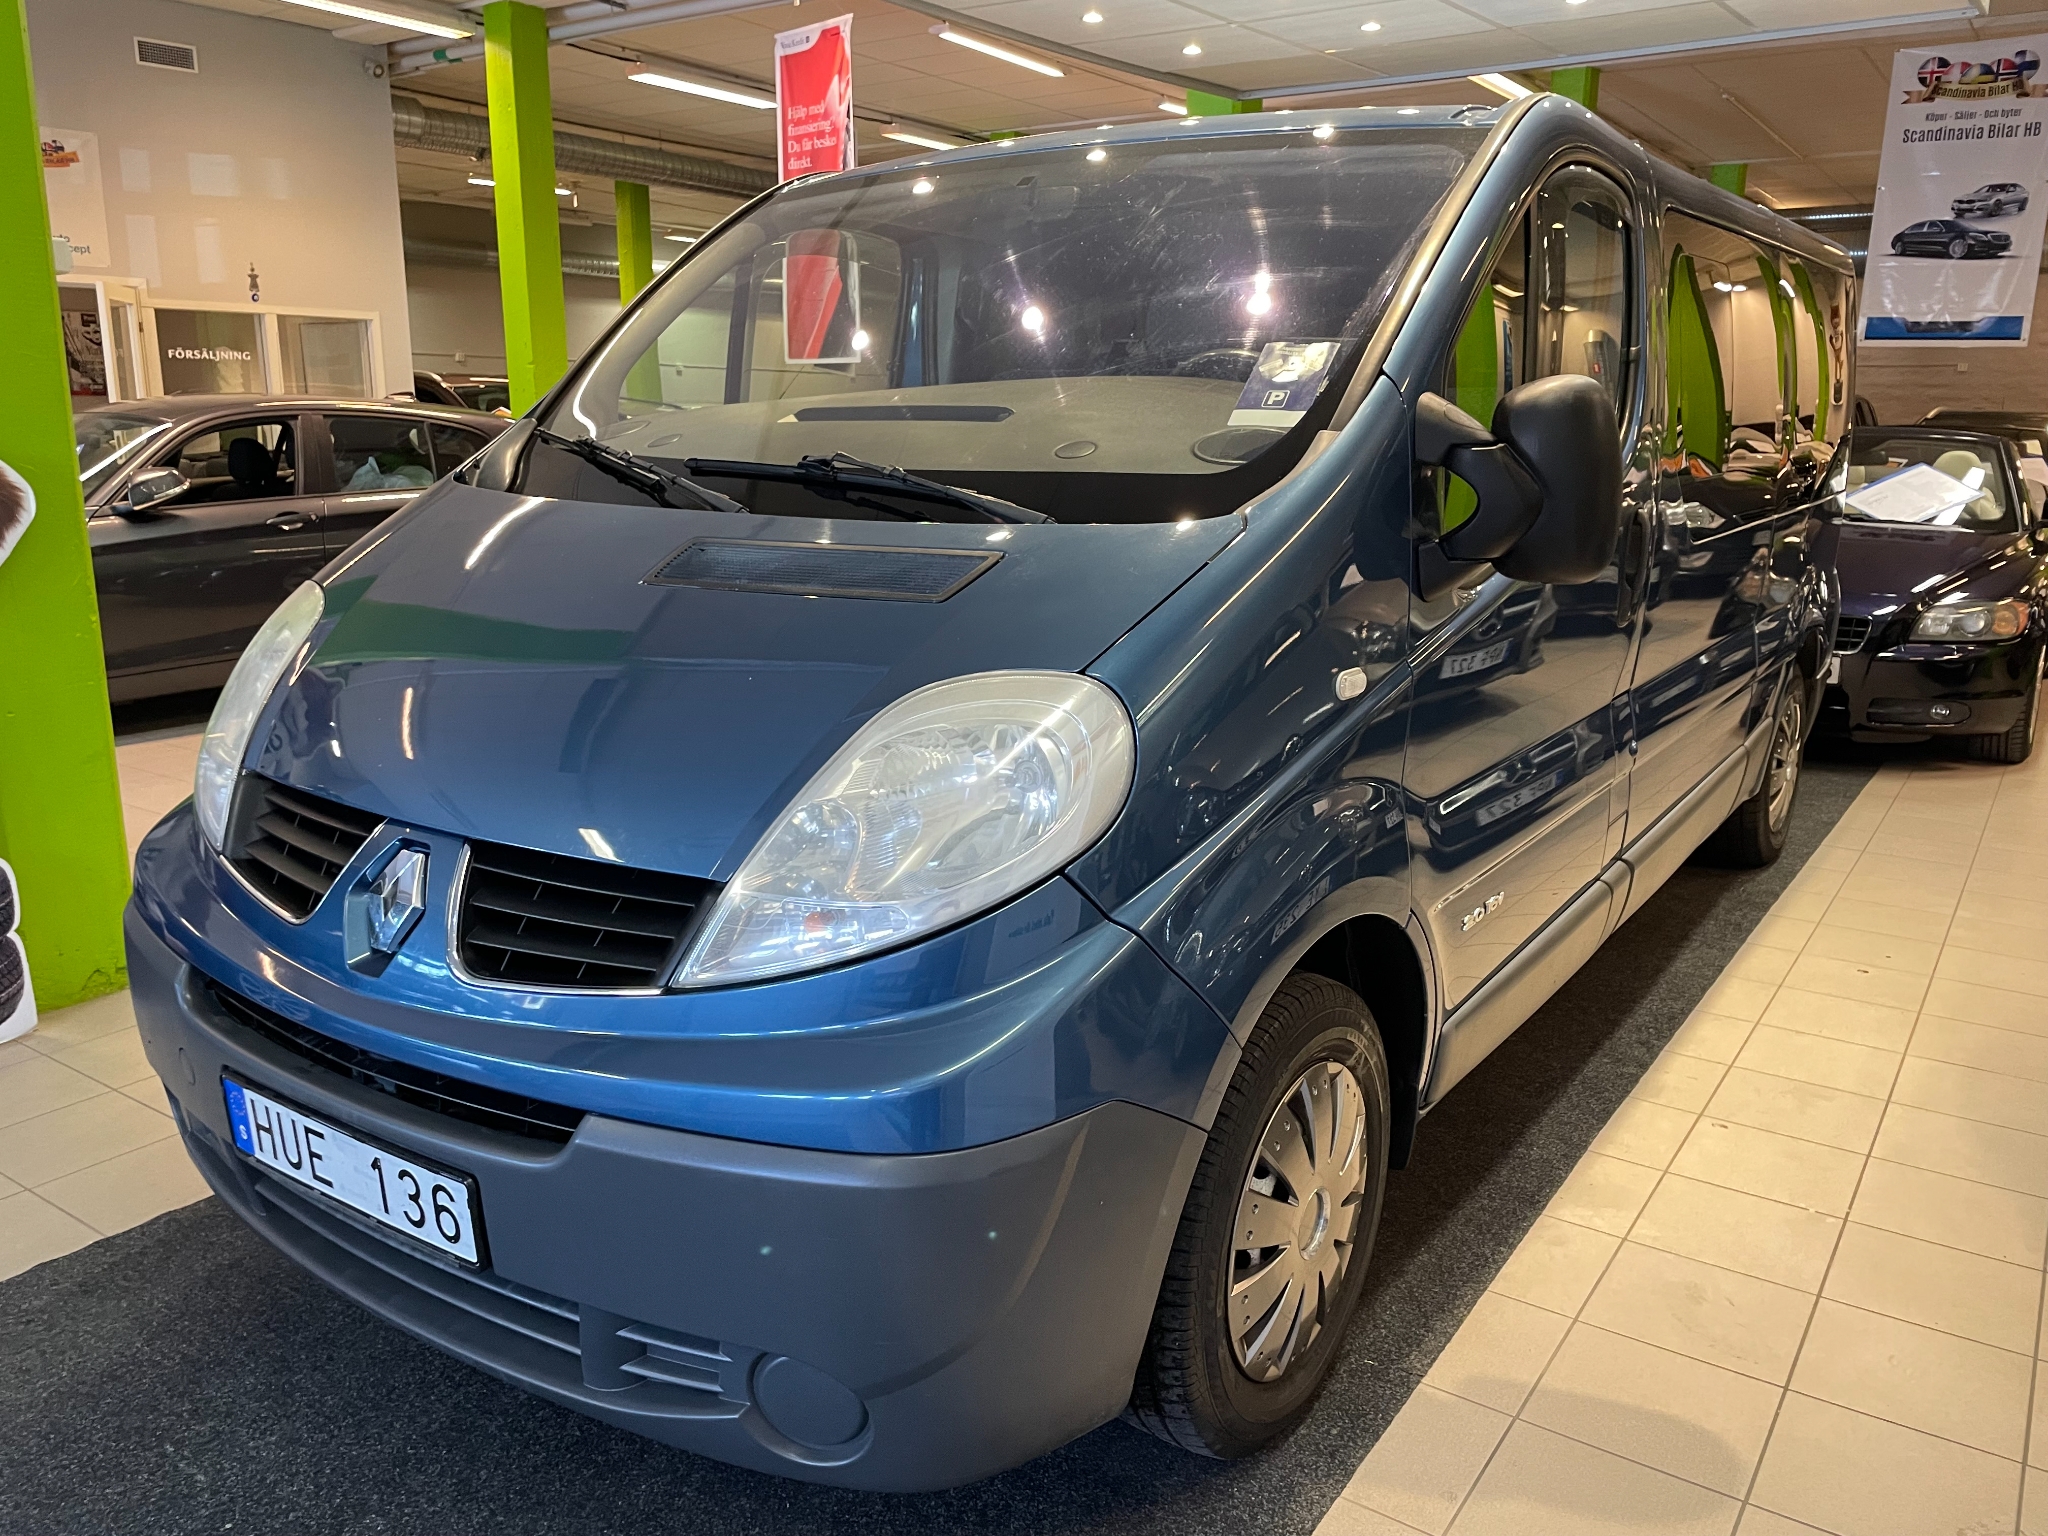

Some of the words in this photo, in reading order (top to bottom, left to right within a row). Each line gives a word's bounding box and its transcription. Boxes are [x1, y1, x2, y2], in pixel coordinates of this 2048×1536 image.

[1932, 83, 1986, 98] Scandinavia
[1988, 85, 2010, 97] Bilar
[1984, 109, 1999, 119] Och
[2001, 108, 2023, 118] byter
[1903, 124, 1984, 143] Scandinavia
[1988, 123, 2021, 139] Bilar
[2024, 121, 2042, 137] HB
[168, 346, 251, 361] FÖRSÄLJNING
[1267, 391, 1286, 405] P
[239, 1124, 248, 1140] S
[250, 1097, 334, 1189] HUE
[370, 1156, 462, 1245] 136
